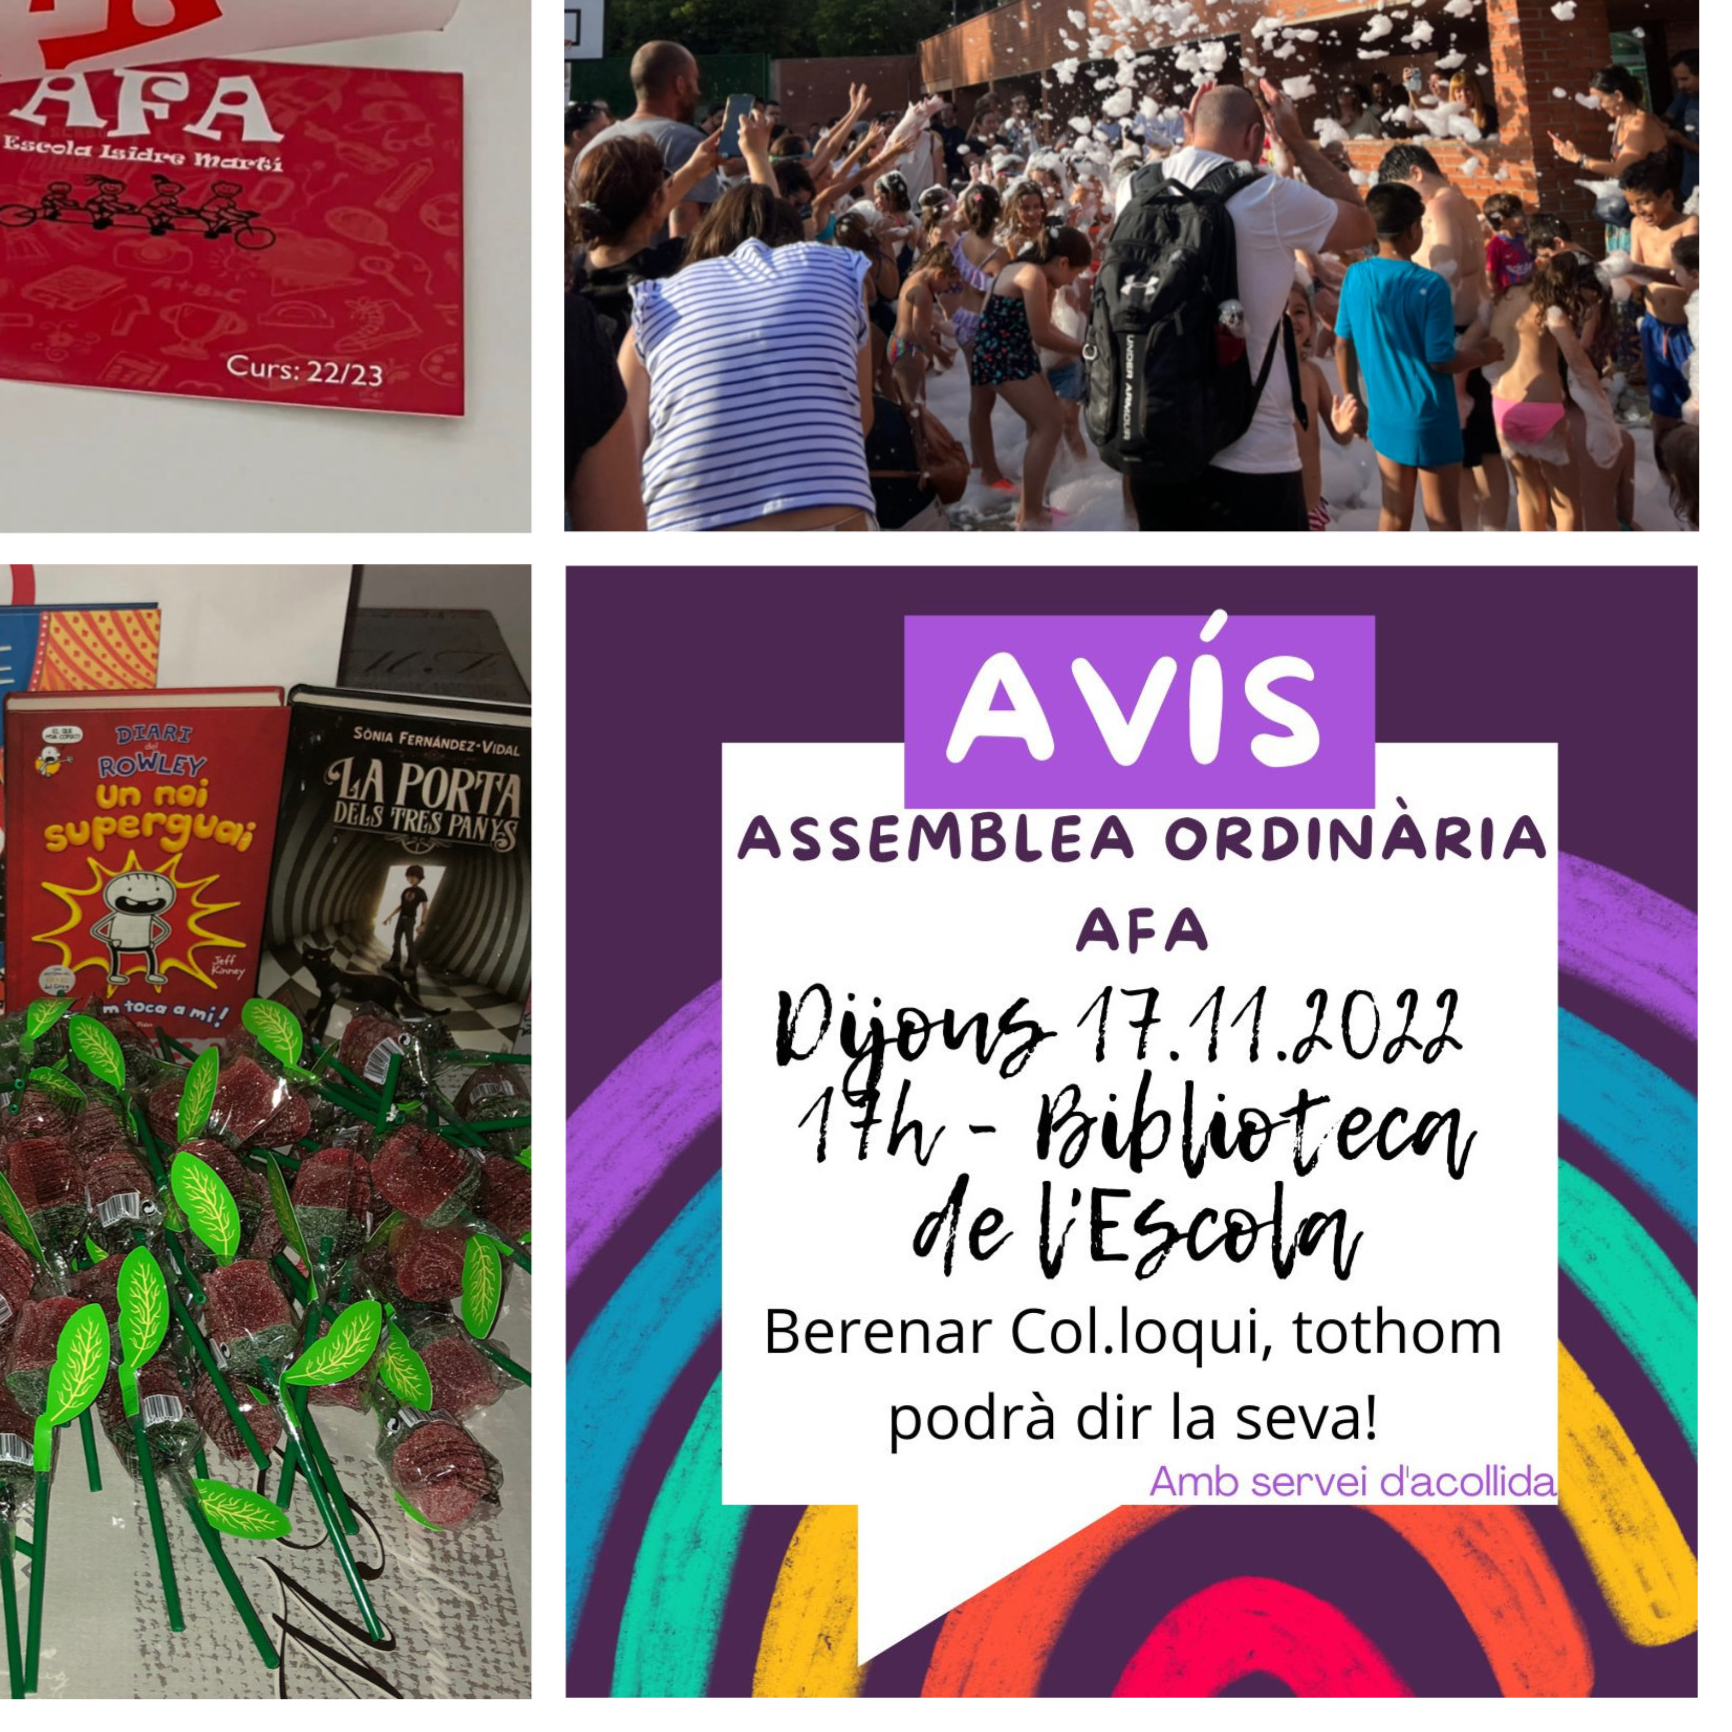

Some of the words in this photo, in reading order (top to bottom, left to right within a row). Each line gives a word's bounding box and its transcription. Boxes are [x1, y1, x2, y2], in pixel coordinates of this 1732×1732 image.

[8, 67, 285, 143] AFA
[3, 135, 92, 158] Escola
[99, 144, 186, 166] Isidre
[226, 354, 299, 383] Curs:
[307, 360, 384, 387] 22/23
[1125, 334, 1135, 379] UNDER
[1122, 382, 1134, 441] ARMOUR
[945, 608, 1321, 768] AVÍS
[116, 723, 193, 745] DIARI
[144, 742, 159, 751] del
[98, 751, 207, 779] ROWLEY
[324, 756, 384, 805] LA
[395, 762, 521, 818] PORTA
[154, 778, 209, 809] noi
[44, 812, 257, 853] superguai
[333, 801, 384, 828] DELS
[391, 807, 443, 835] TRES
[448, 813, 518, 853] PANYS
[736, 811, 1136, 864] ASSEMBLEA
[1164, 796, 1548, 862] ORDINÀRIA
[1075, 907, 1210, 955] AFA
[211, 966, 246, 981] Kinney
[213, 955, 237, 966] Jeff
[124, 1000, 168, 1015] toca
[173, 1003, 186, 1016] a
[189, 1006, 229, 1028] mi!
[776, 982, 1057, 1106] Dijous
[1076, 985, 1464, 1065] 17.11.2022
[797, 1078, 946, 1167] 17h
[1036, 1069, 1478, 1181] Biblioteca
[912, 1171, 1015, 1278] de
[1039, 1179, 1364, 1281] l'Escola
[766, 1308, 992, 1355] Berenar
[1011, 1305, 1274, 1368] Col.loqui,
[1291, 1305, 1502, 1355] tothom
[890, 1391, 1055, 1454] podrà
[1076, 1391, 1152, 1441] dir
[1171, 1391, 1217, 1441] la
[1236, 1393, 1378, 1441] seva!
[1150, 1464, 1240, 1498] Amb
[1250, 1465, 1368, 1498] servei
[1380, 1463, 1558, 1498] d'acollida
